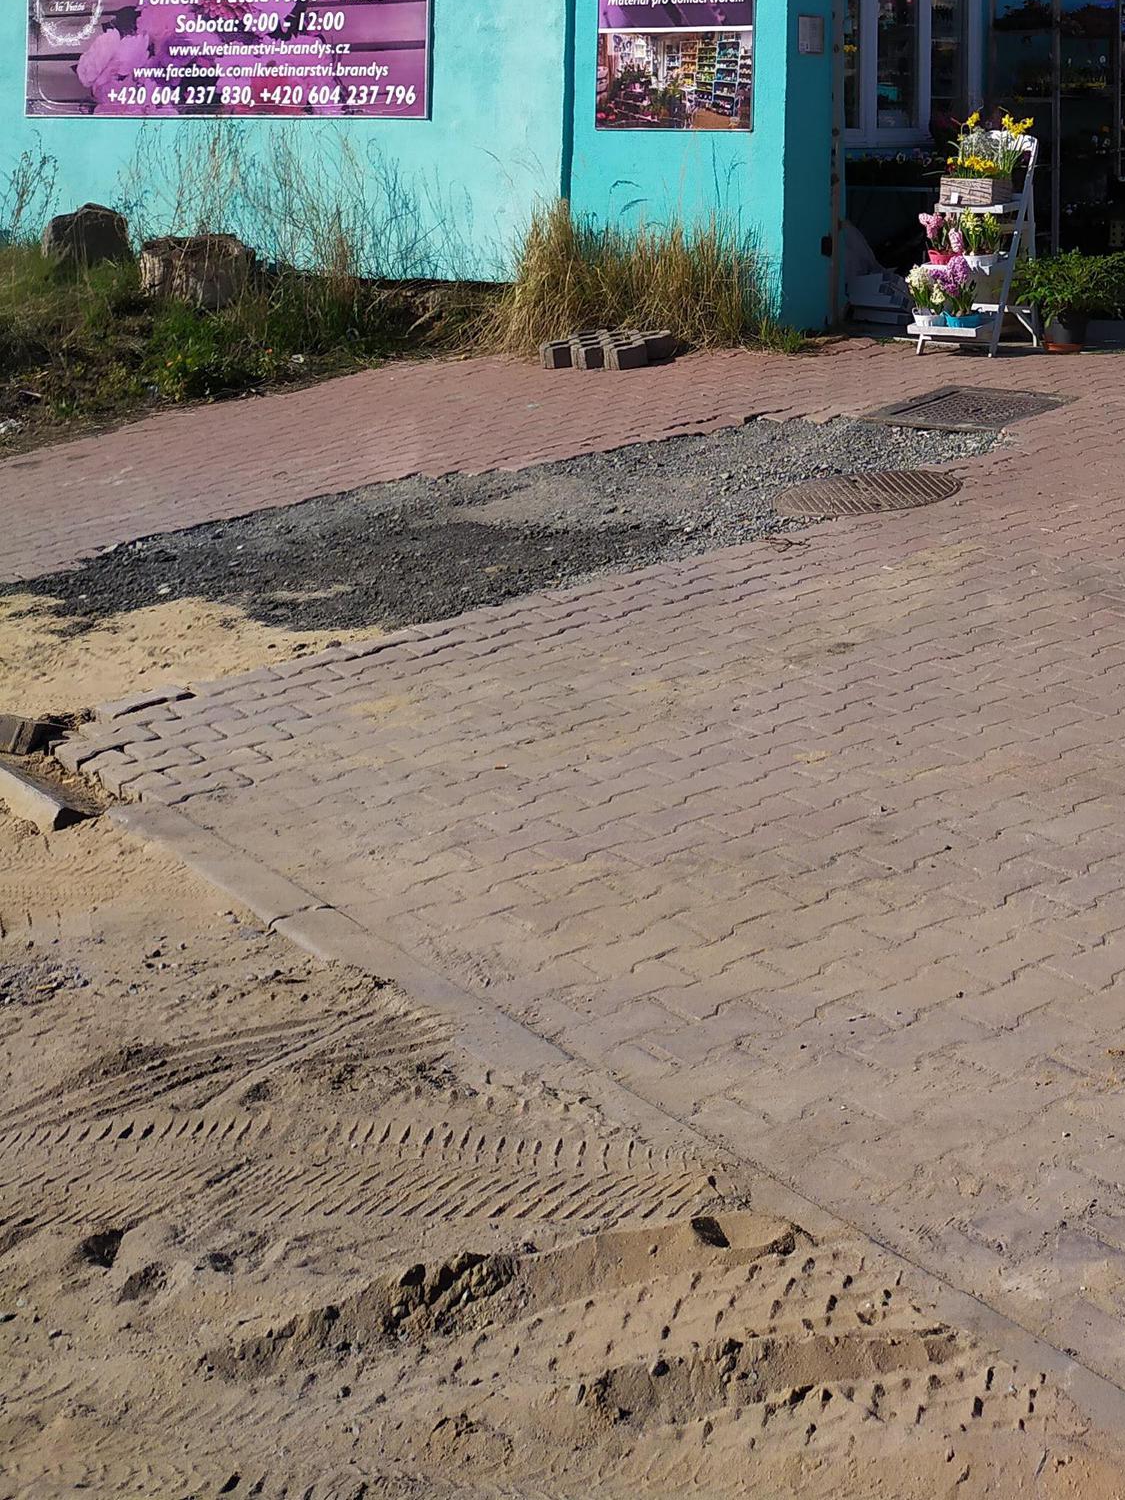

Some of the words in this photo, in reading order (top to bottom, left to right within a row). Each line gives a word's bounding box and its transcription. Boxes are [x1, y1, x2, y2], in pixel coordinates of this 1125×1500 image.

[175, 14, 239, 33] Sobota:
[242, 12, 279, 32] 9:00
[298, 11, 345, 31] 12:00
[169, 40, 350, 59] www.kvetinarstvi-brandys.cz
[133, 62, 389, 81] www.facebook.com/kvetinarstvi.brandys
[107, 86, 147, 105] +420
[151, 86, 181, 105] 604
[185, 86, 216, 104] 237
[220, 86, 256, 107] 830,
[260, 85, 303, 105] +420
[308, 85, 341, 104] 604
[346, 85, 379, 104] 237
[385, 85, 417, 104] 796
